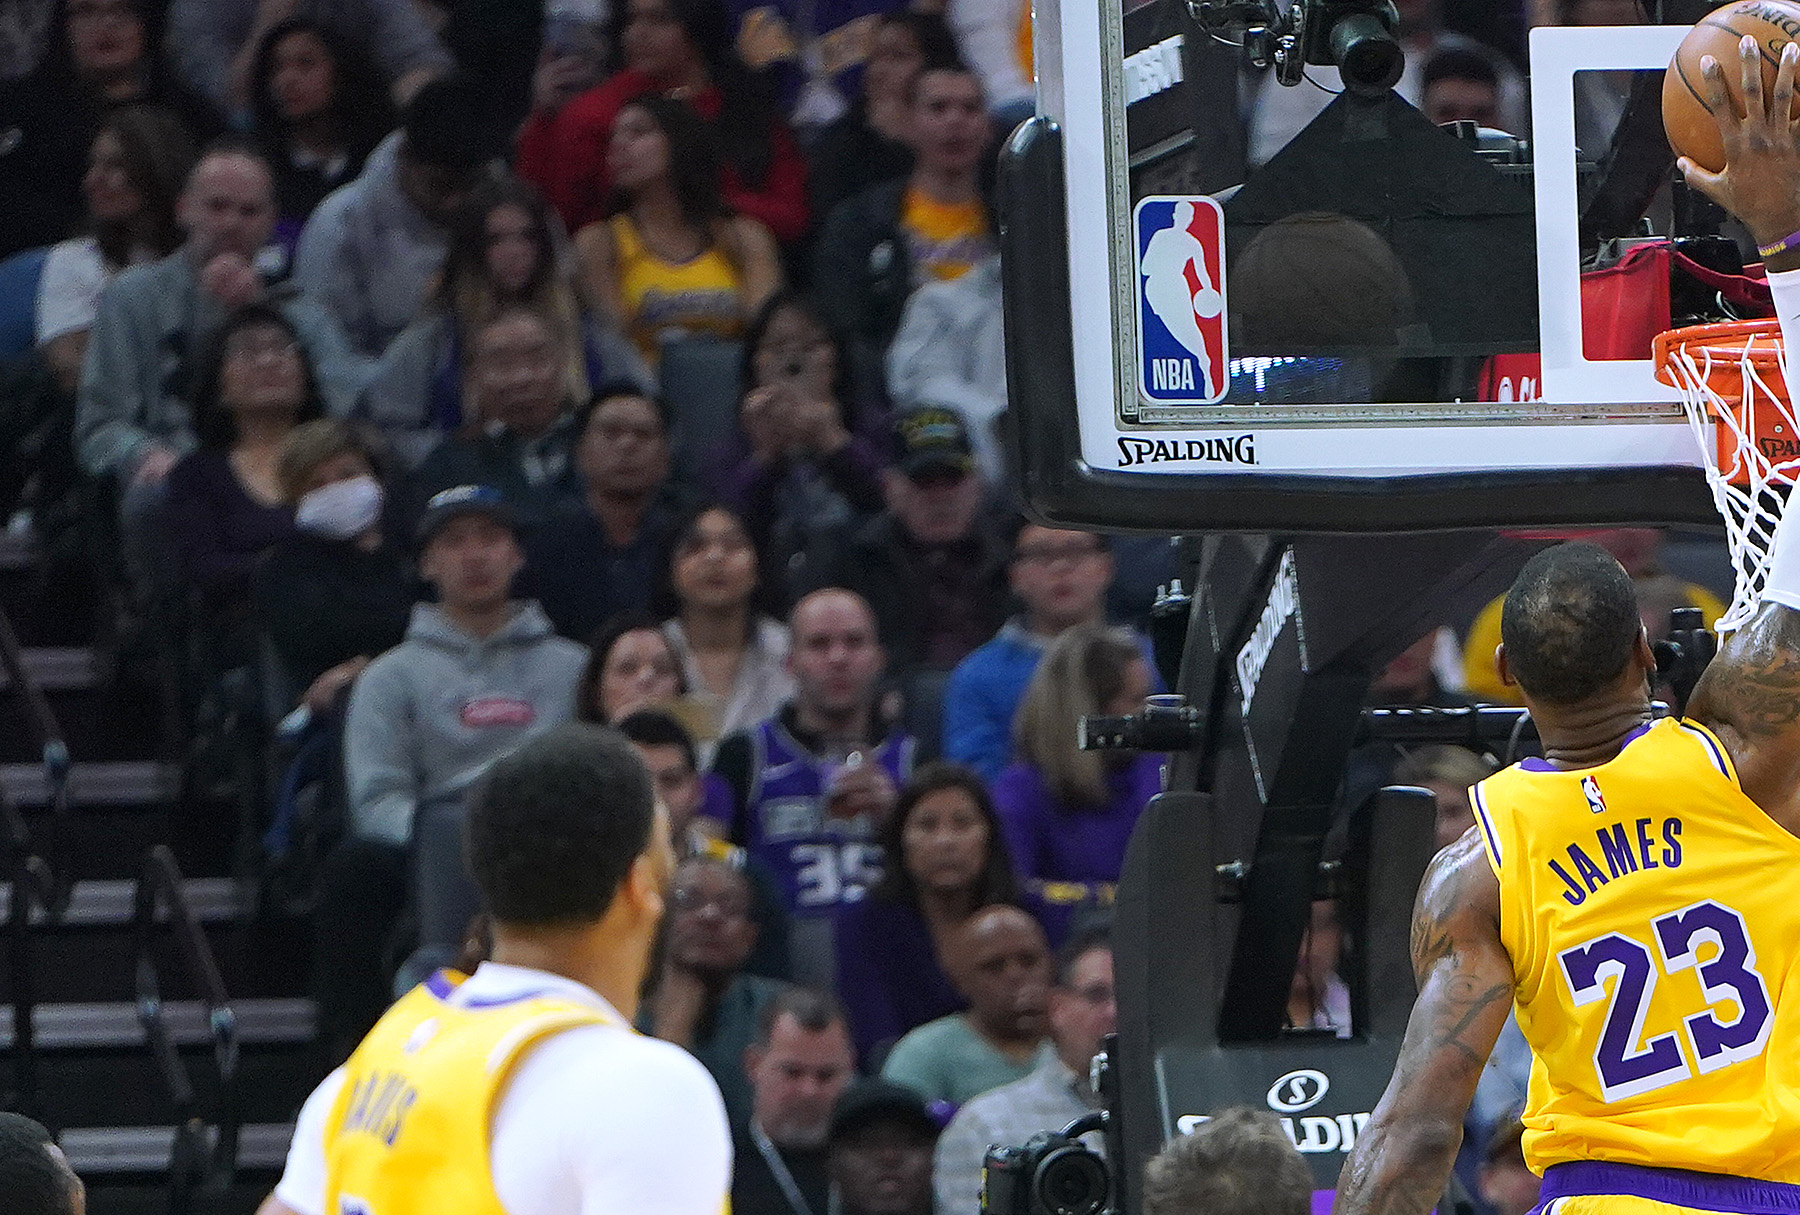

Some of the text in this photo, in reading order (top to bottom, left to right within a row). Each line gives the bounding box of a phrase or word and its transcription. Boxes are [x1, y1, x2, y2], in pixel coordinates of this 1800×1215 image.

[1152, 358, 1195, 390] NBA
[1117, 434, 1256, 467] SPALDING
[1548, 817, 1683, 906] JAMES
[1556, 898, 1775, 1104] 23
